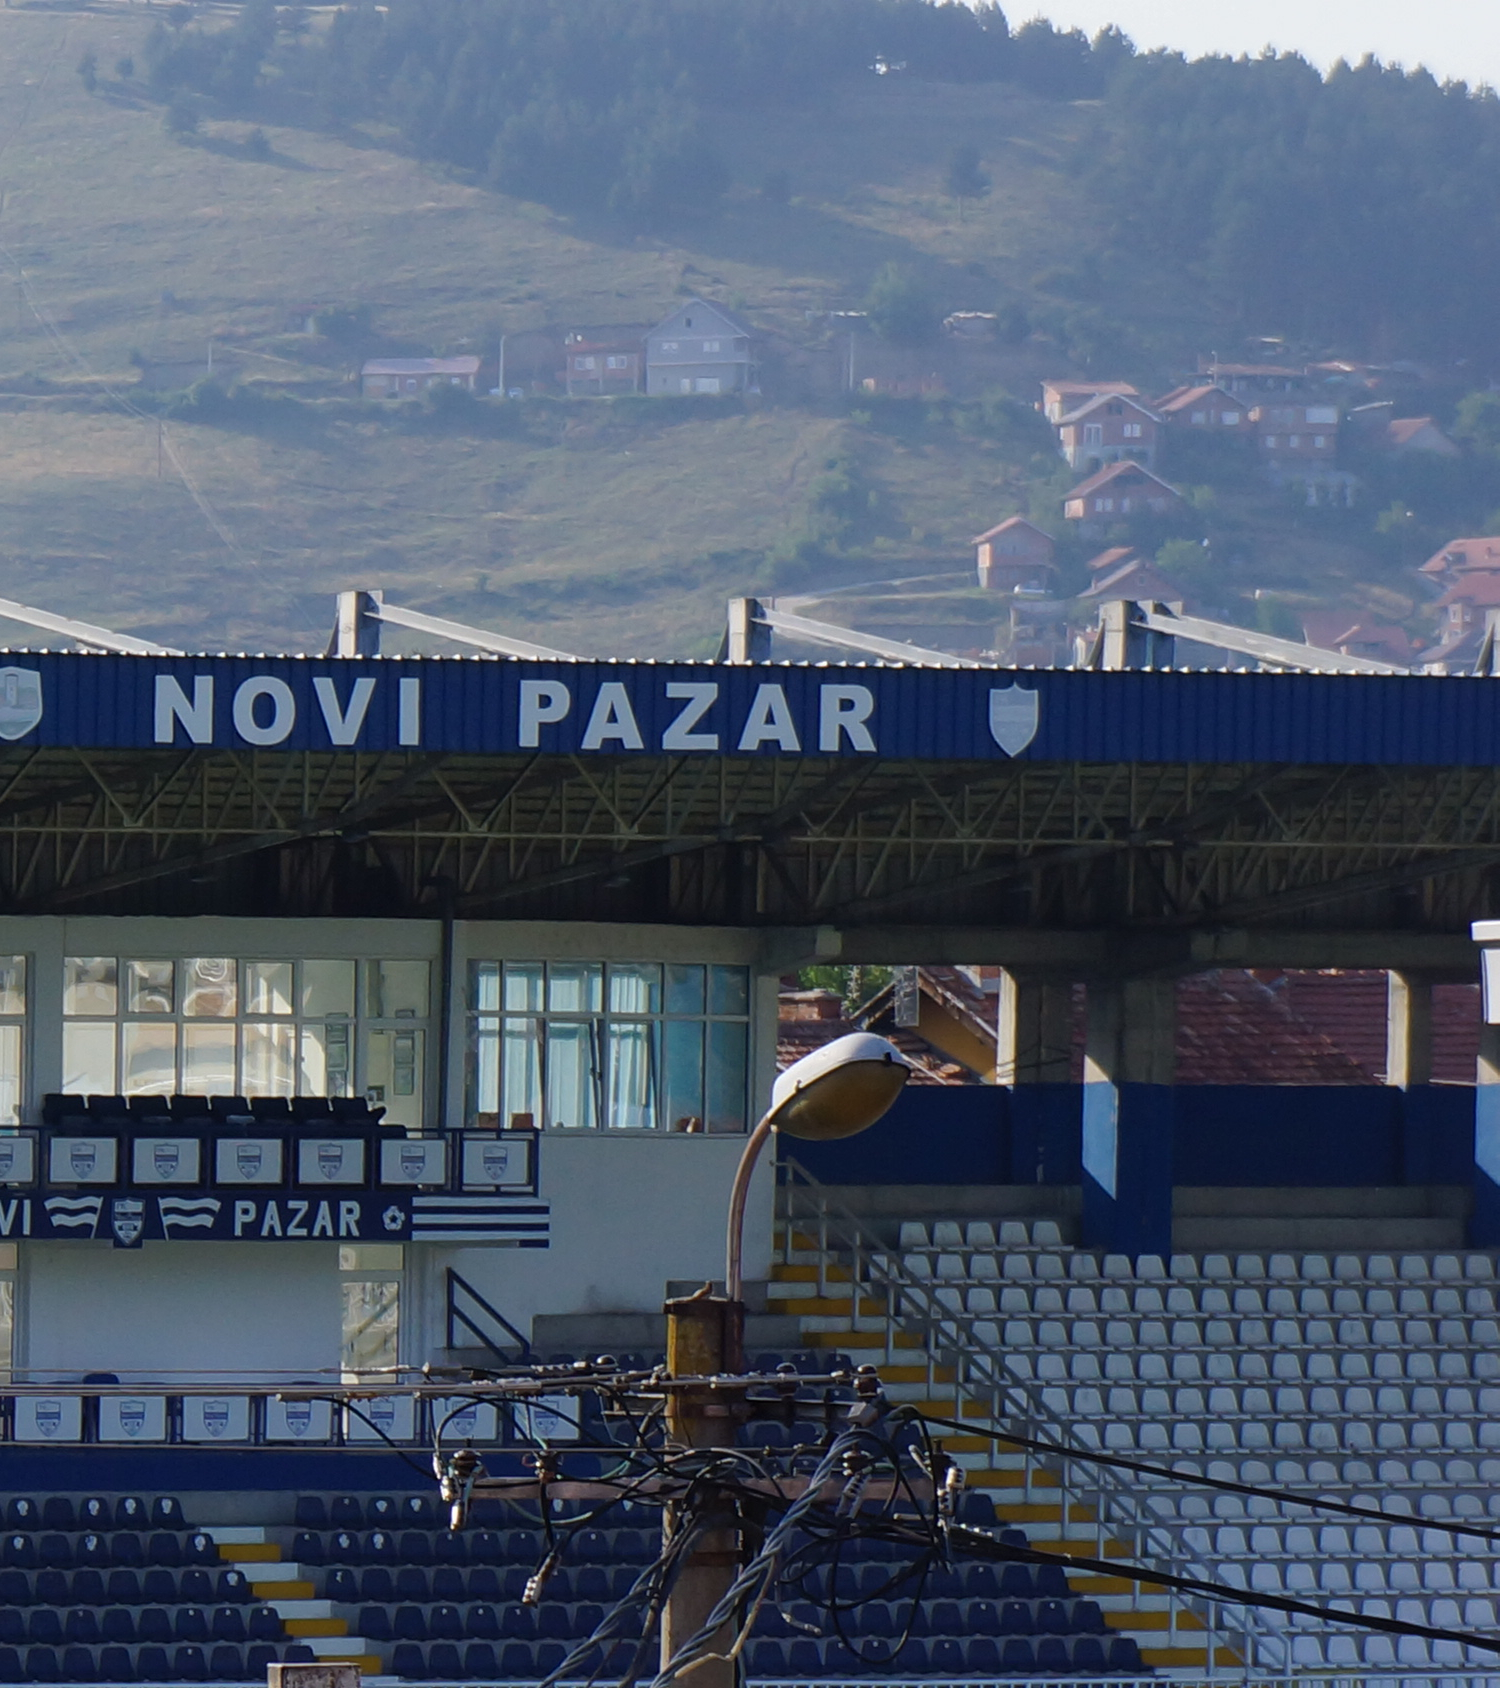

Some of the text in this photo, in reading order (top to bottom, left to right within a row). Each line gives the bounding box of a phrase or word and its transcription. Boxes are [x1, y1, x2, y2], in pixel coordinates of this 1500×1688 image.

[152, 675, 878, 753] NOVI PAZAR
[234, 1200, 361, 1237] PAZAR
